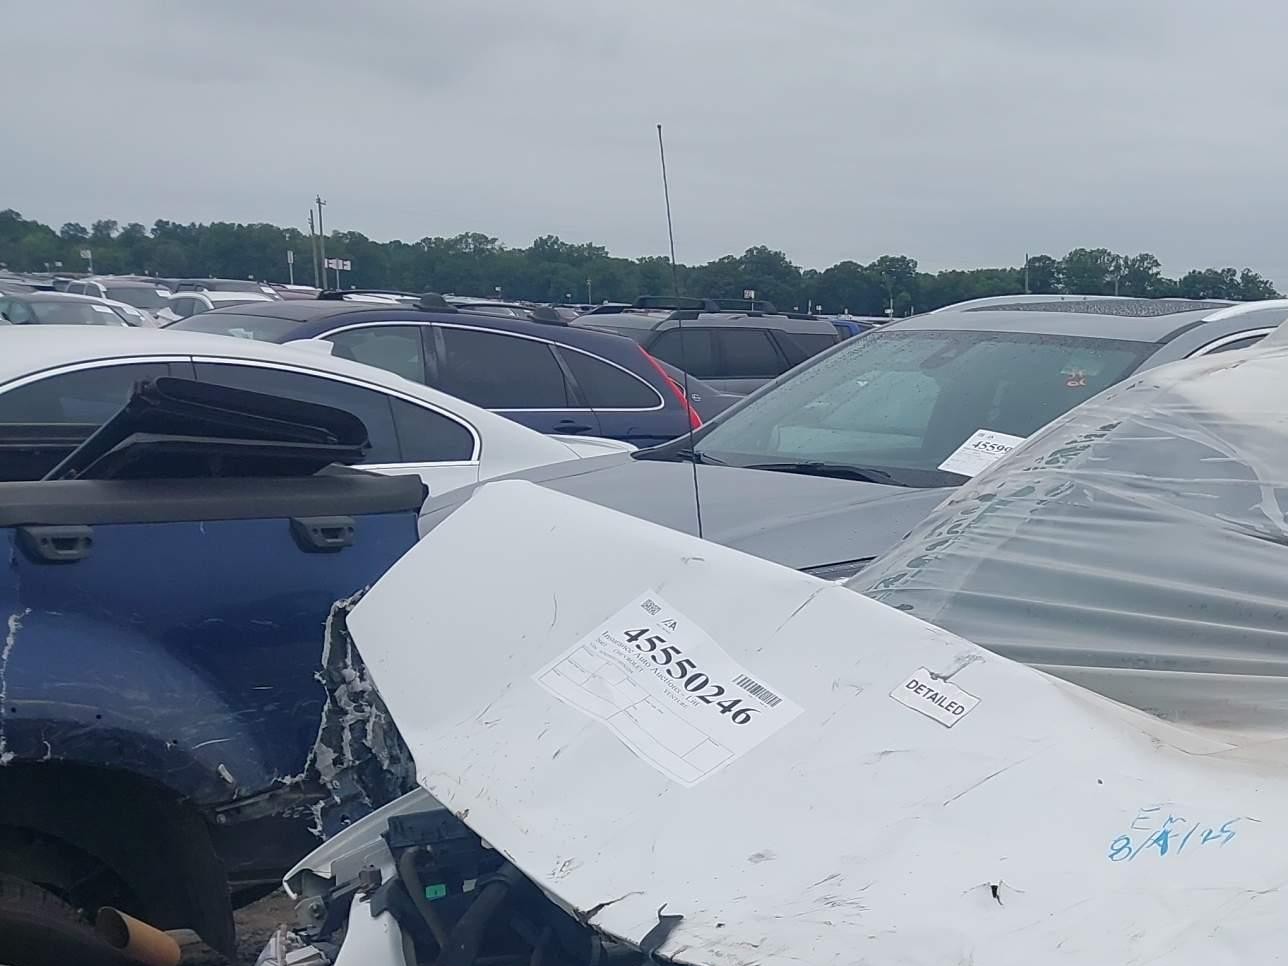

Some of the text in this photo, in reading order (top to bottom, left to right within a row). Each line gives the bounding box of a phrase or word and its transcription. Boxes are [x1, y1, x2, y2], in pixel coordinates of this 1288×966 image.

[623, 628, 761, 725] 45550246
[633, 652, 652, 668] Auto
[651, 667, 682, 694] Auctions
[905, 679, 965, 716] DETAILED
